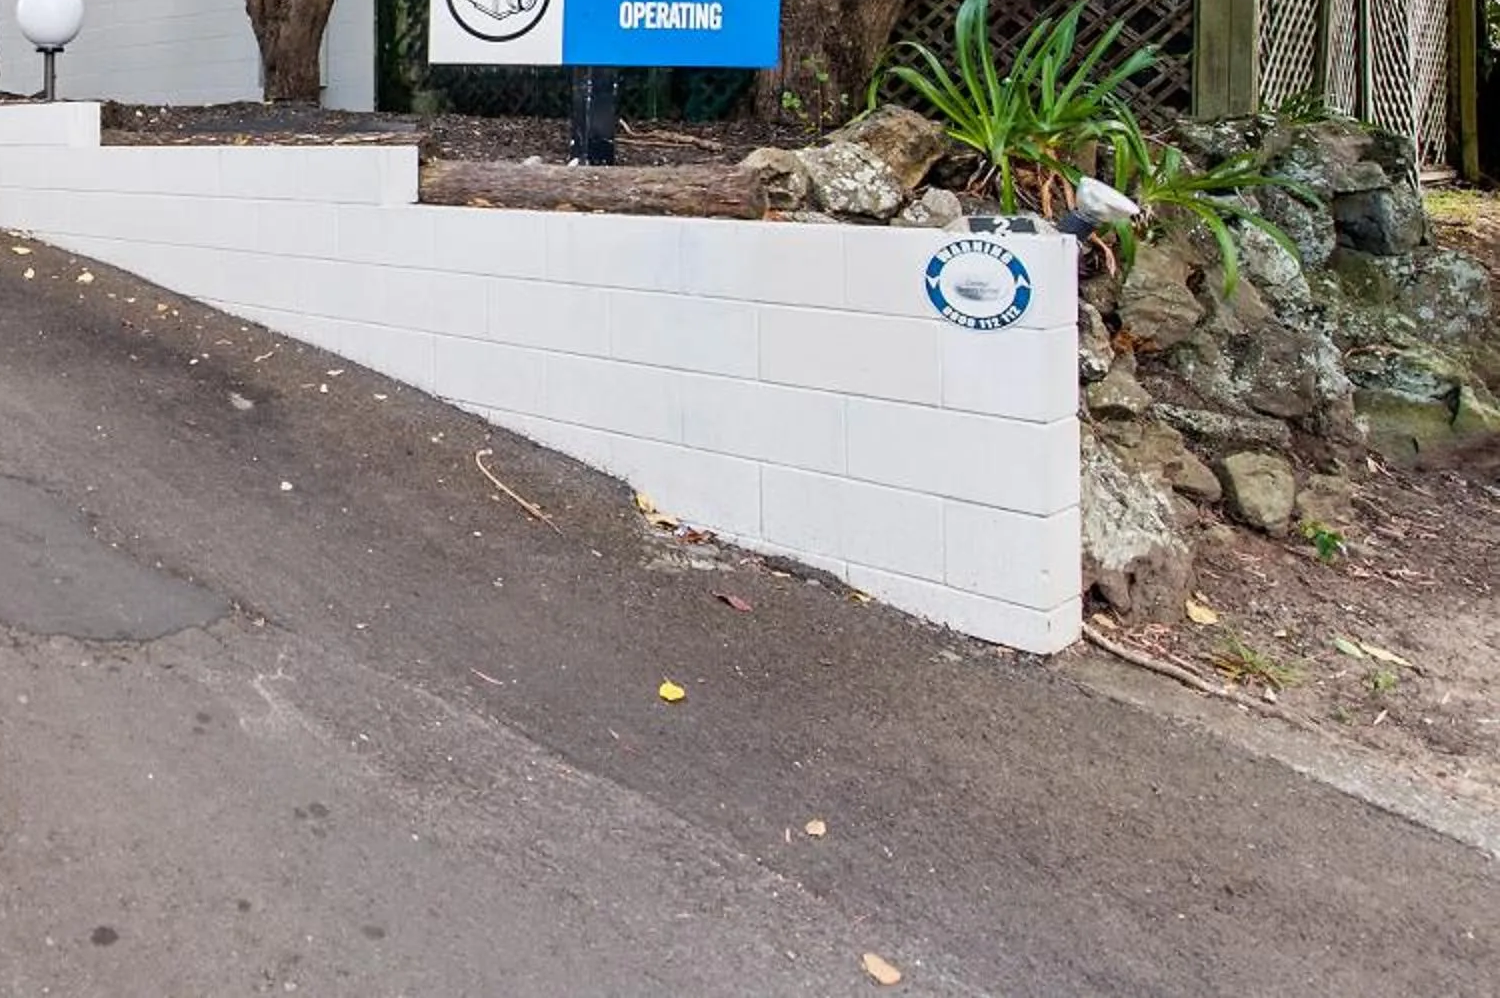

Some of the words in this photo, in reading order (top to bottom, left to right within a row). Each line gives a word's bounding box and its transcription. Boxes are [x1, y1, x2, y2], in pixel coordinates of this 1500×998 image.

[619, 2, 722, 30] OPERATING
[937, 240, 1014, 263] WARNING
[942, 305, 976, 327] 0800
[979, 317, 1002, 329] 112
